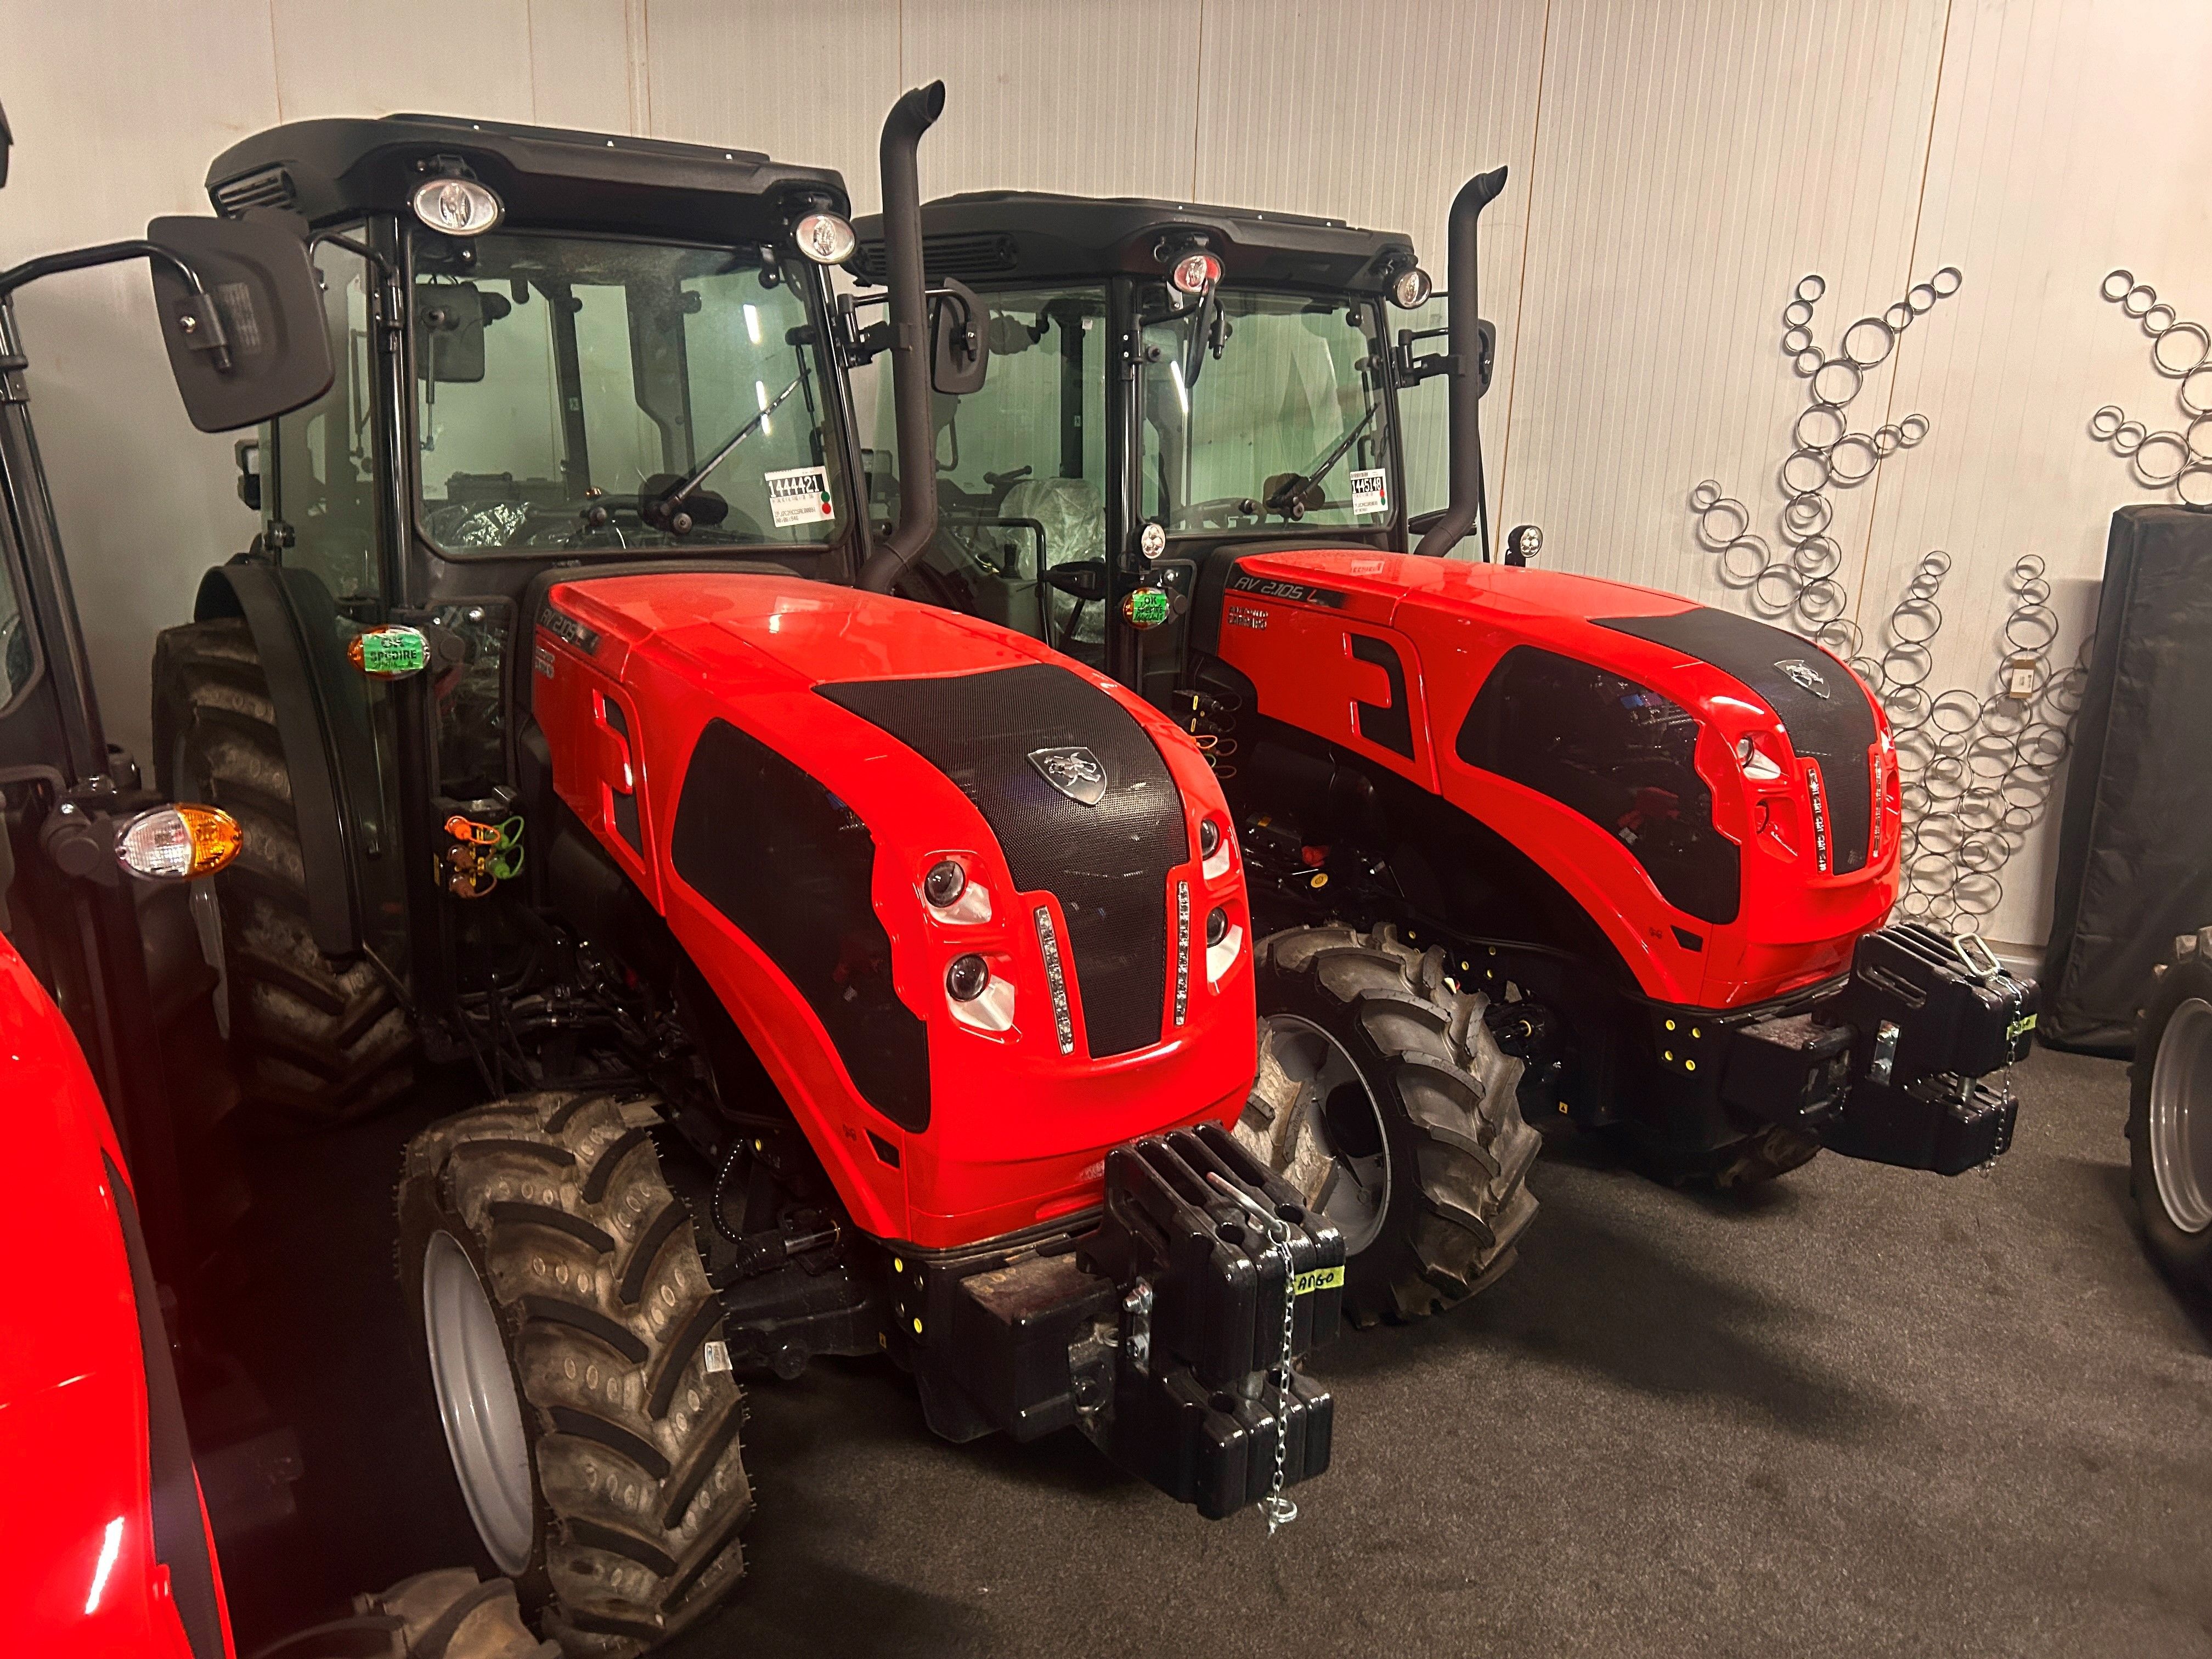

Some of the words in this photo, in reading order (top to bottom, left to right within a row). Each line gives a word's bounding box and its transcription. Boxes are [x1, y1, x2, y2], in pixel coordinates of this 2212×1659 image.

[769, 475, 820, 498] 1444421
[1352, 477, 1381, 493] 1445148
[1234, 577, 1261, 591] AV
[1261, 582, 1304, 600] 2.105
[1307, 589, 1317, 602] L
[1144, 596, 1156, 605] OK
[370, 650, 417, 662] SPEDIRE
